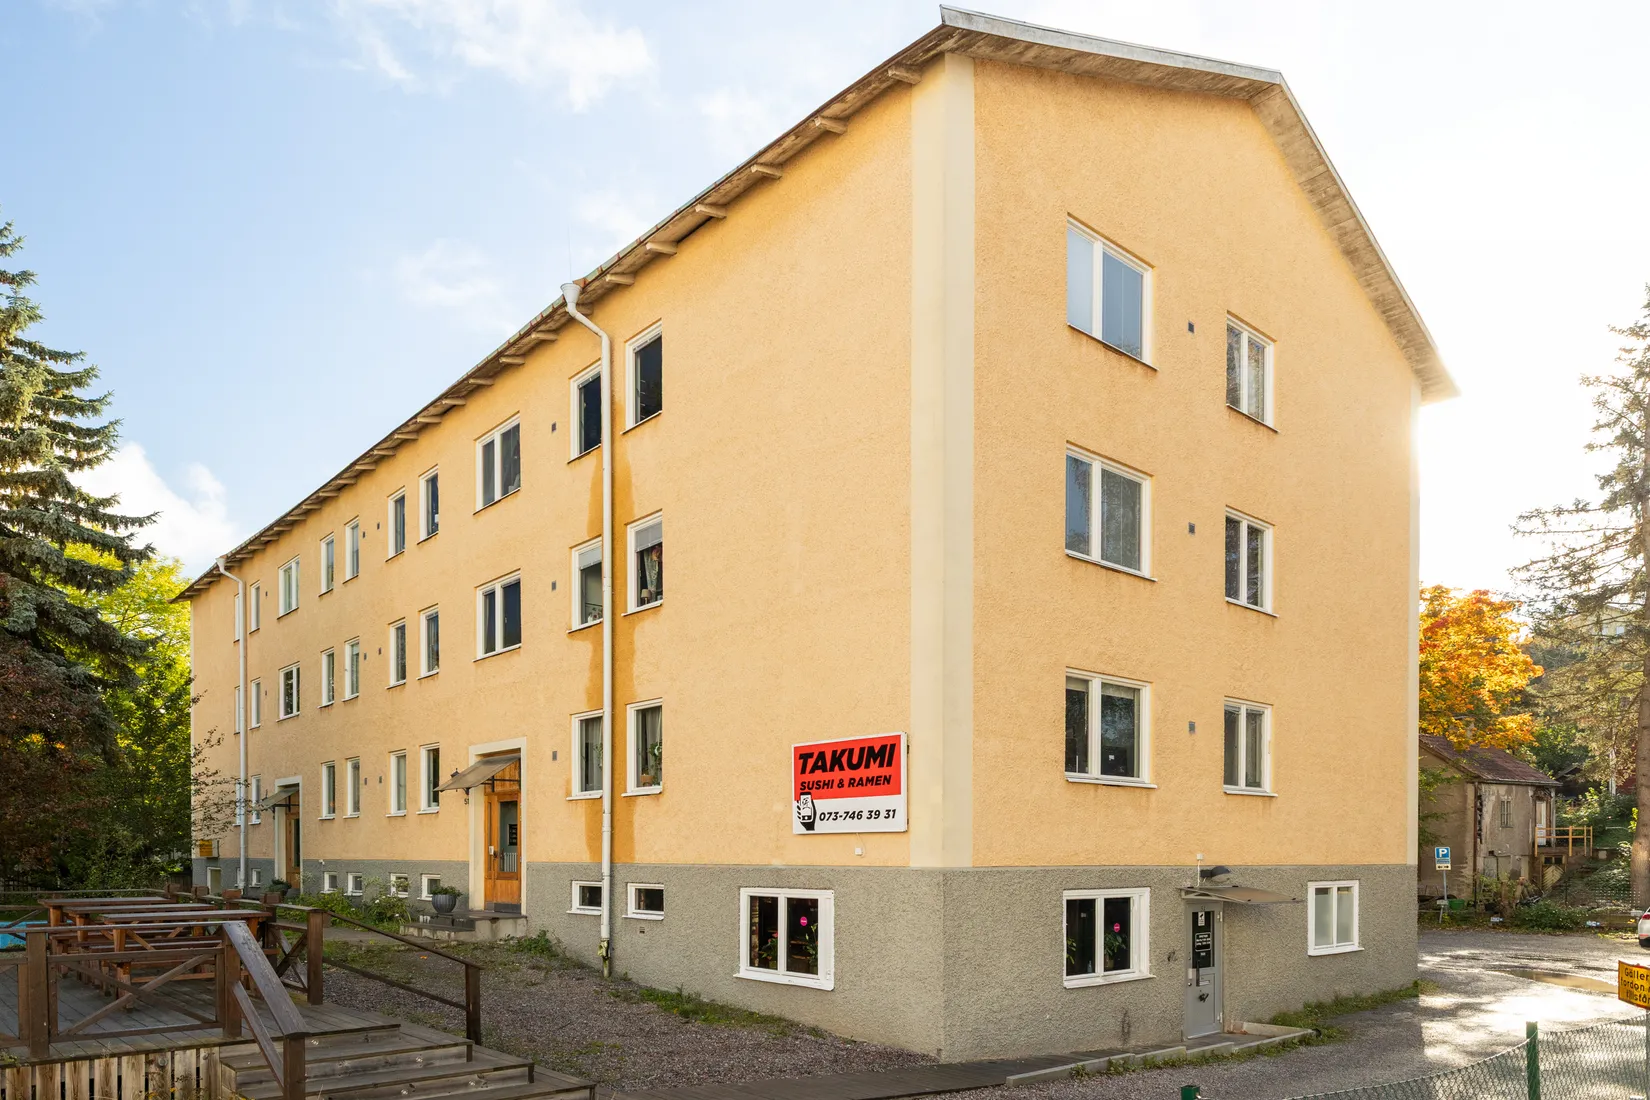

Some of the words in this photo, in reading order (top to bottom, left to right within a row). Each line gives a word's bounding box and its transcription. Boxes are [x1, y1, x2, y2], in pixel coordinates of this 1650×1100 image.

[799, 743, 896, 774] TAKUMI
[800, 779, 834, 791] SUSHI
[837, 778, 844, 788] &
[848, 775, 892, 788] RAMEN
[819, 811, 863, 821] 073-746
[866, 810, 881, 820] 39
[884, 809, 896, 819] 31
[1439, 848, 1447, 857] P
[1624, 967, 1650, 981] Gäller
